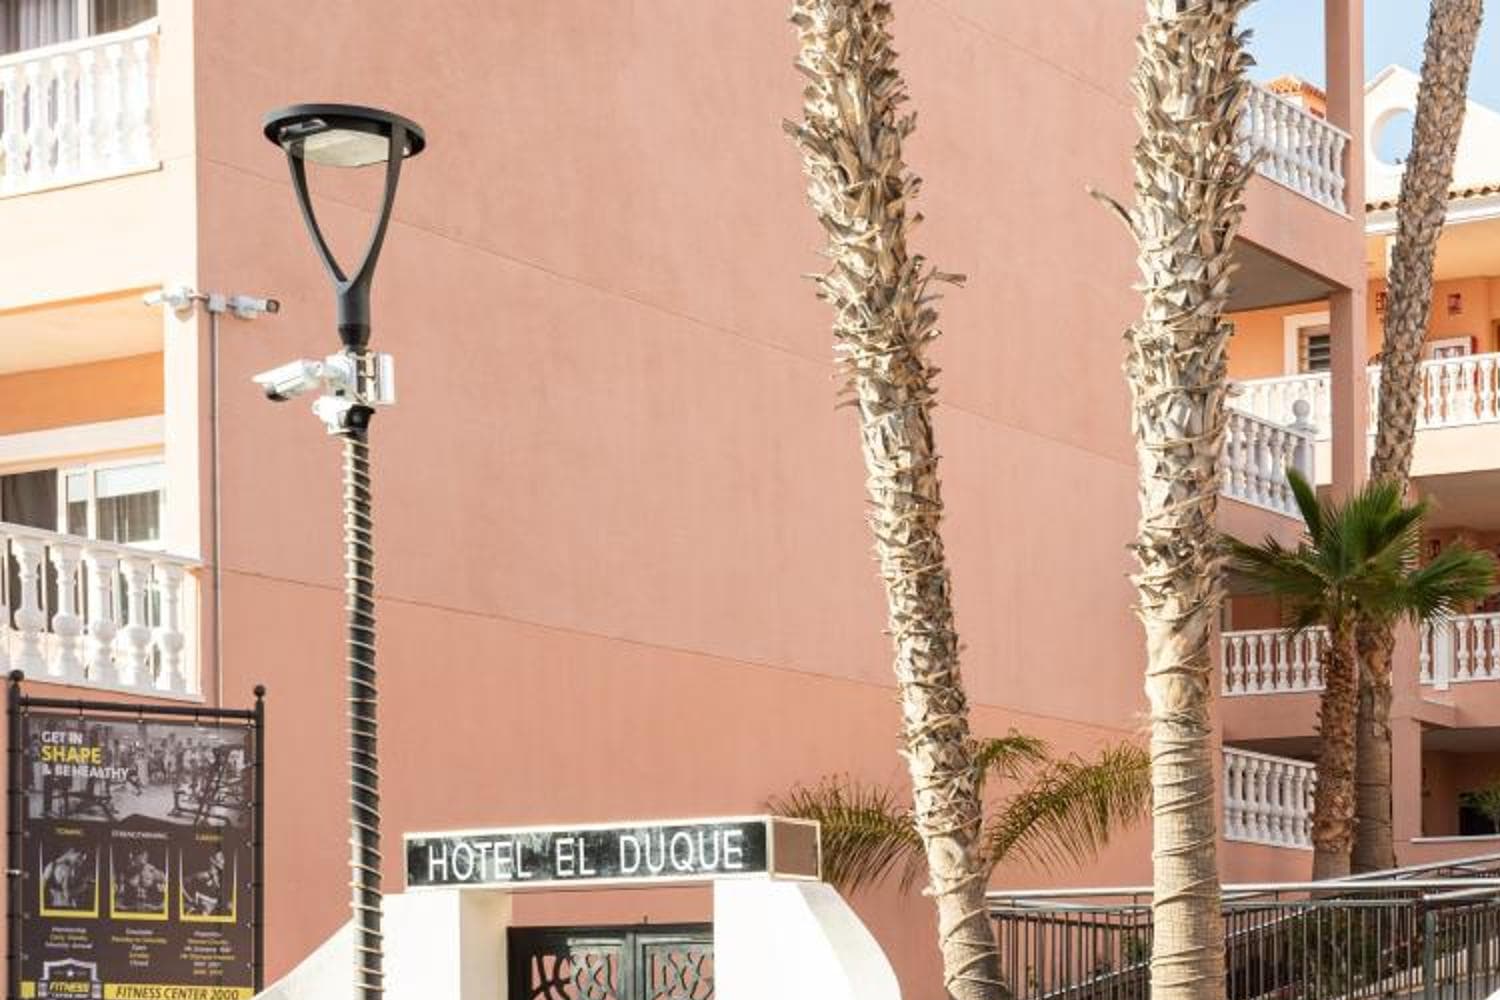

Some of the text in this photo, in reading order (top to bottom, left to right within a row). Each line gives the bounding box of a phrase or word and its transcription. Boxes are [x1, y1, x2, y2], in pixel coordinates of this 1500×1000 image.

[42, 731, 83, 744] GET IN
[41, 745, 103, 764] SHAPE
[54, 764, 72, 777] BE
[72, 765, 130, 781] HEALTHY
[428, 830, 744, 881] HOTEL EL DUQUE
[49, 981, 90, 993] FITNESS
[115, 985, 162, 1000] FITNESS
[164, 987, 207, 1000] CENTER
